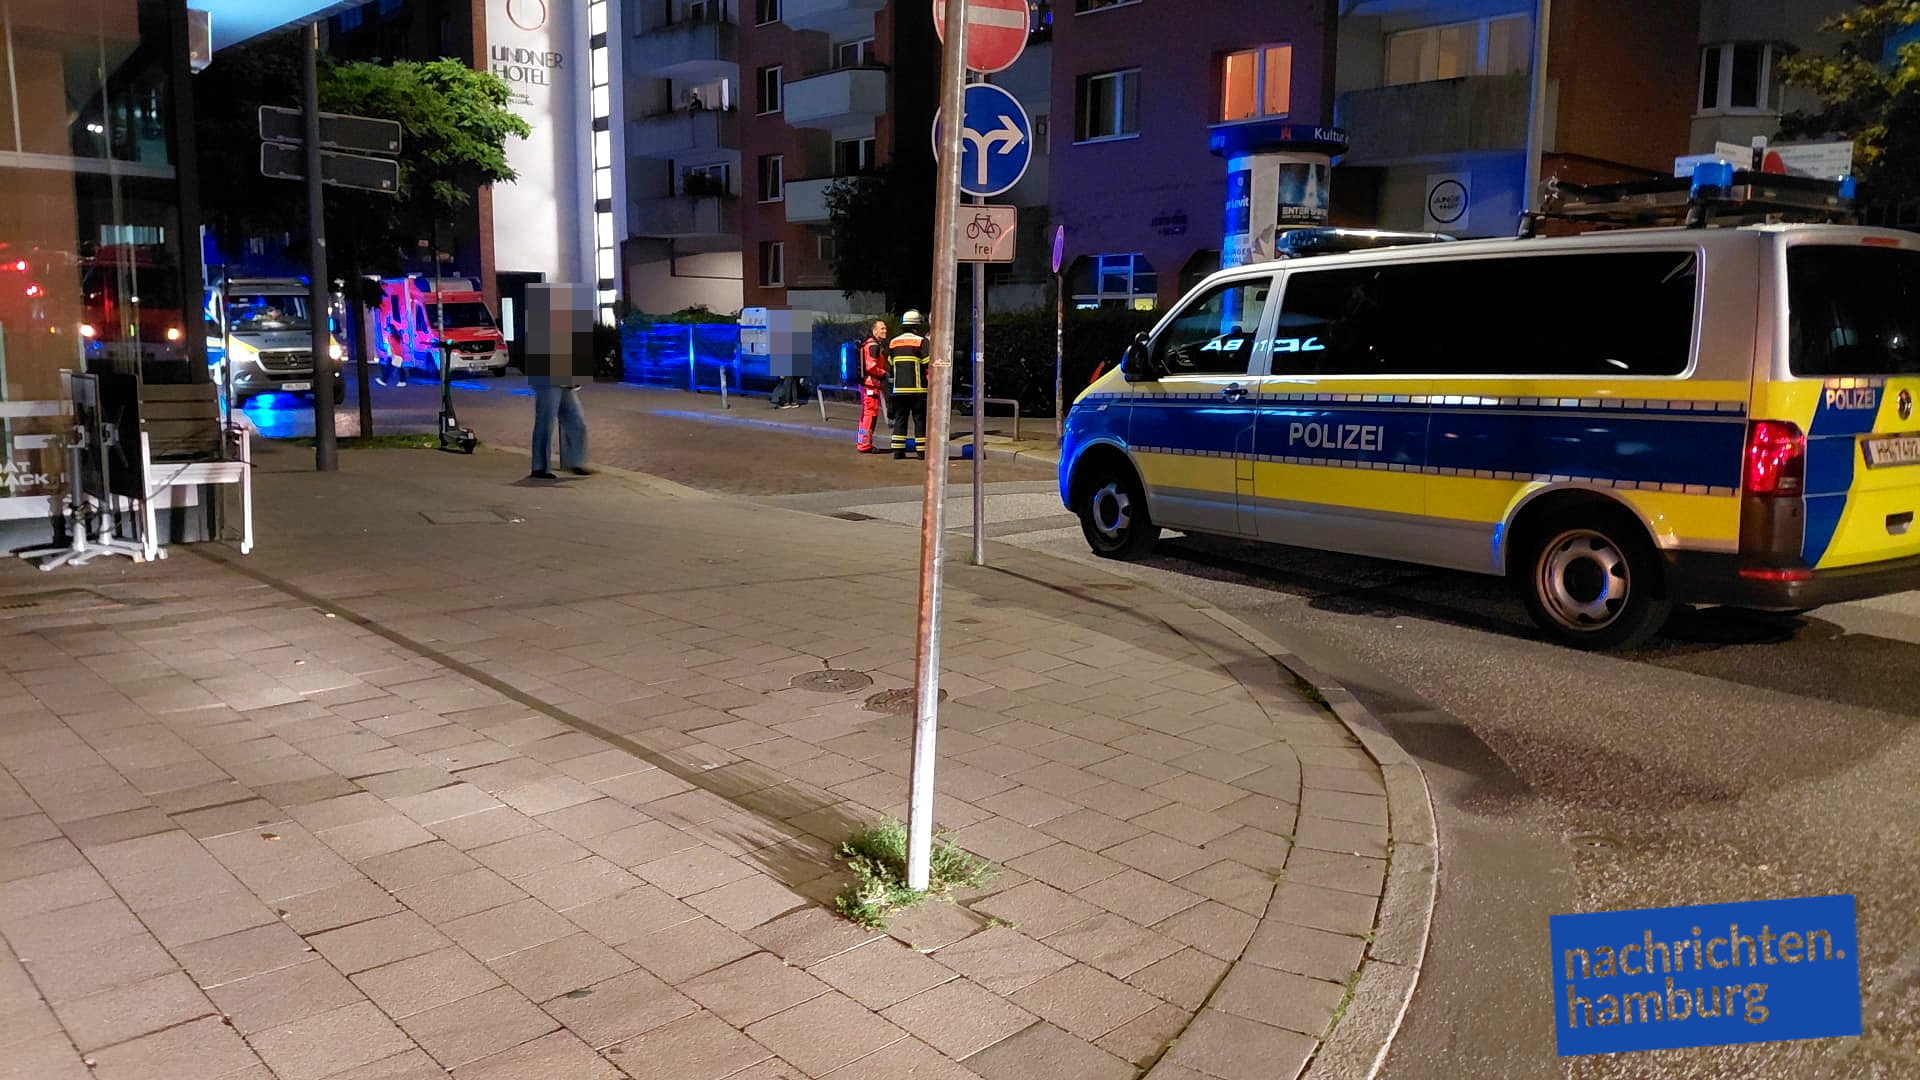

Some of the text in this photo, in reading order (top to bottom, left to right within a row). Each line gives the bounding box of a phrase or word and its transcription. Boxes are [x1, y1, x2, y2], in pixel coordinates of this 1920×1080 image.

[491, 45, 563, 69] LINDNER
[492, 63, 551, 86] HOTEL
[974, 242, 993, 255] frei
[1825, 388, 1876, 410] POLIZEI
[1288, 422, 1384, 451] POLIZEI
